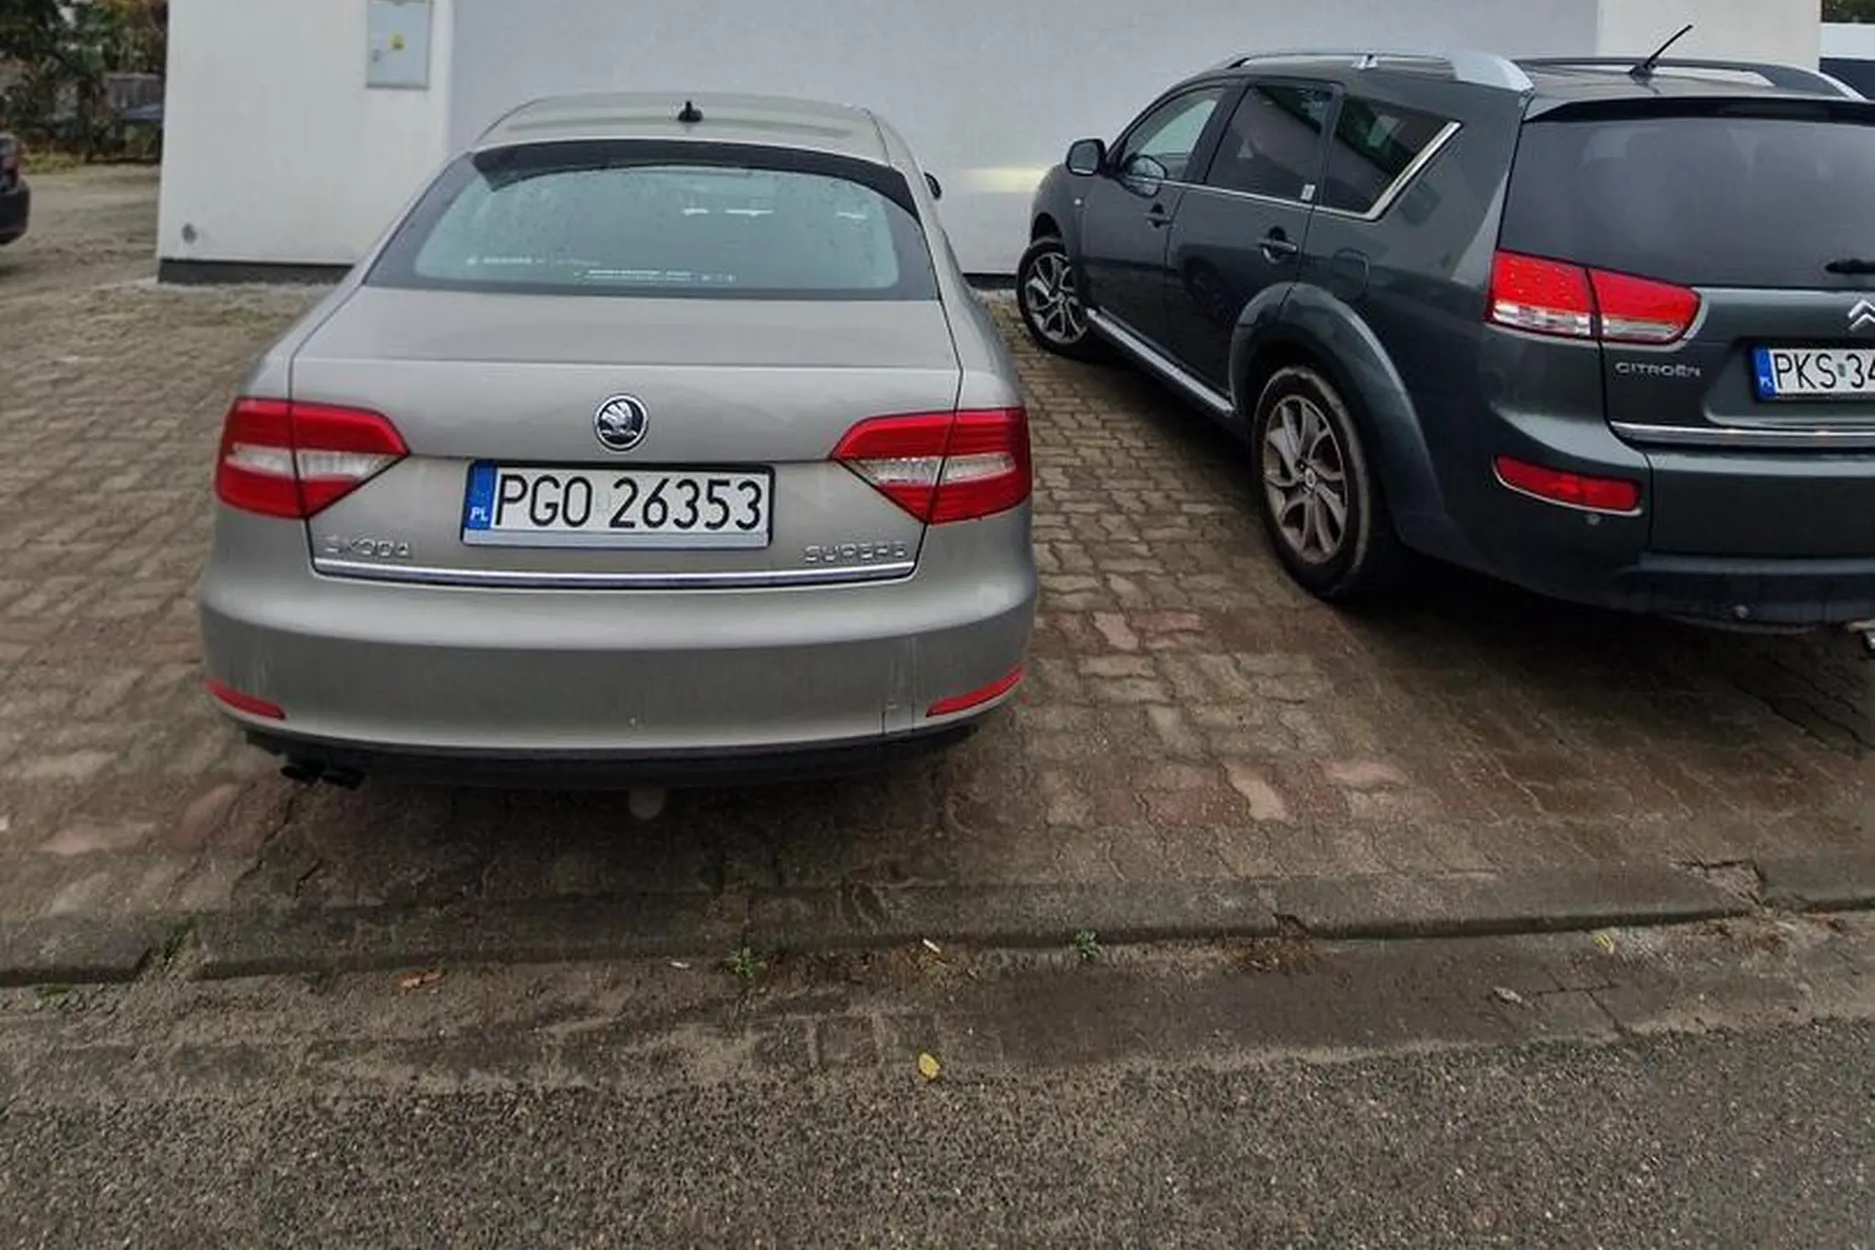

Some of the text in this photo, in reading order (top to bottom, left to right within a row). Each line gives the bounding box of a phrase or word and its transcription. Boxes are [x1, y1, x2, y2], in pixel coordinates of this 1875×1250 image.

[1773, 353, 1837, 389] PKS
[469, 508, 489, 522] PL
[494, 473, 763, 531] PGO 26353
